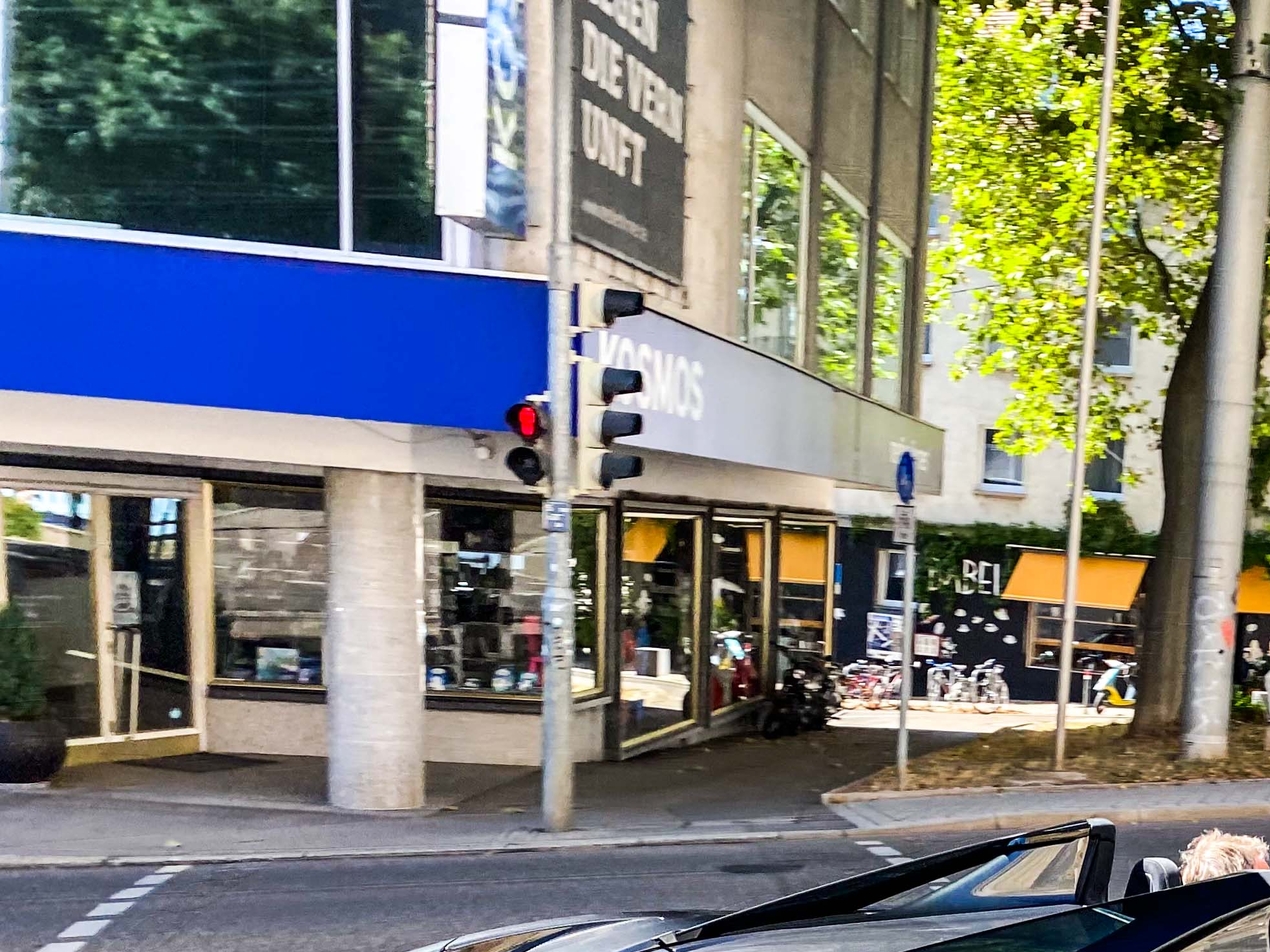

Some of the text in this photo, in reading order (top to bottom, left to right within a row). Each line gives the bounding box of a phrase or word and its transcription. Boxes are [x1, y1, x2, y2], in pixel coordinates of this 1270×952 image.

[582, 19, 624, 99] DIE
[581, 99, 647, 187] UNFT
[598, 330, 704, 421] KOSMOS
